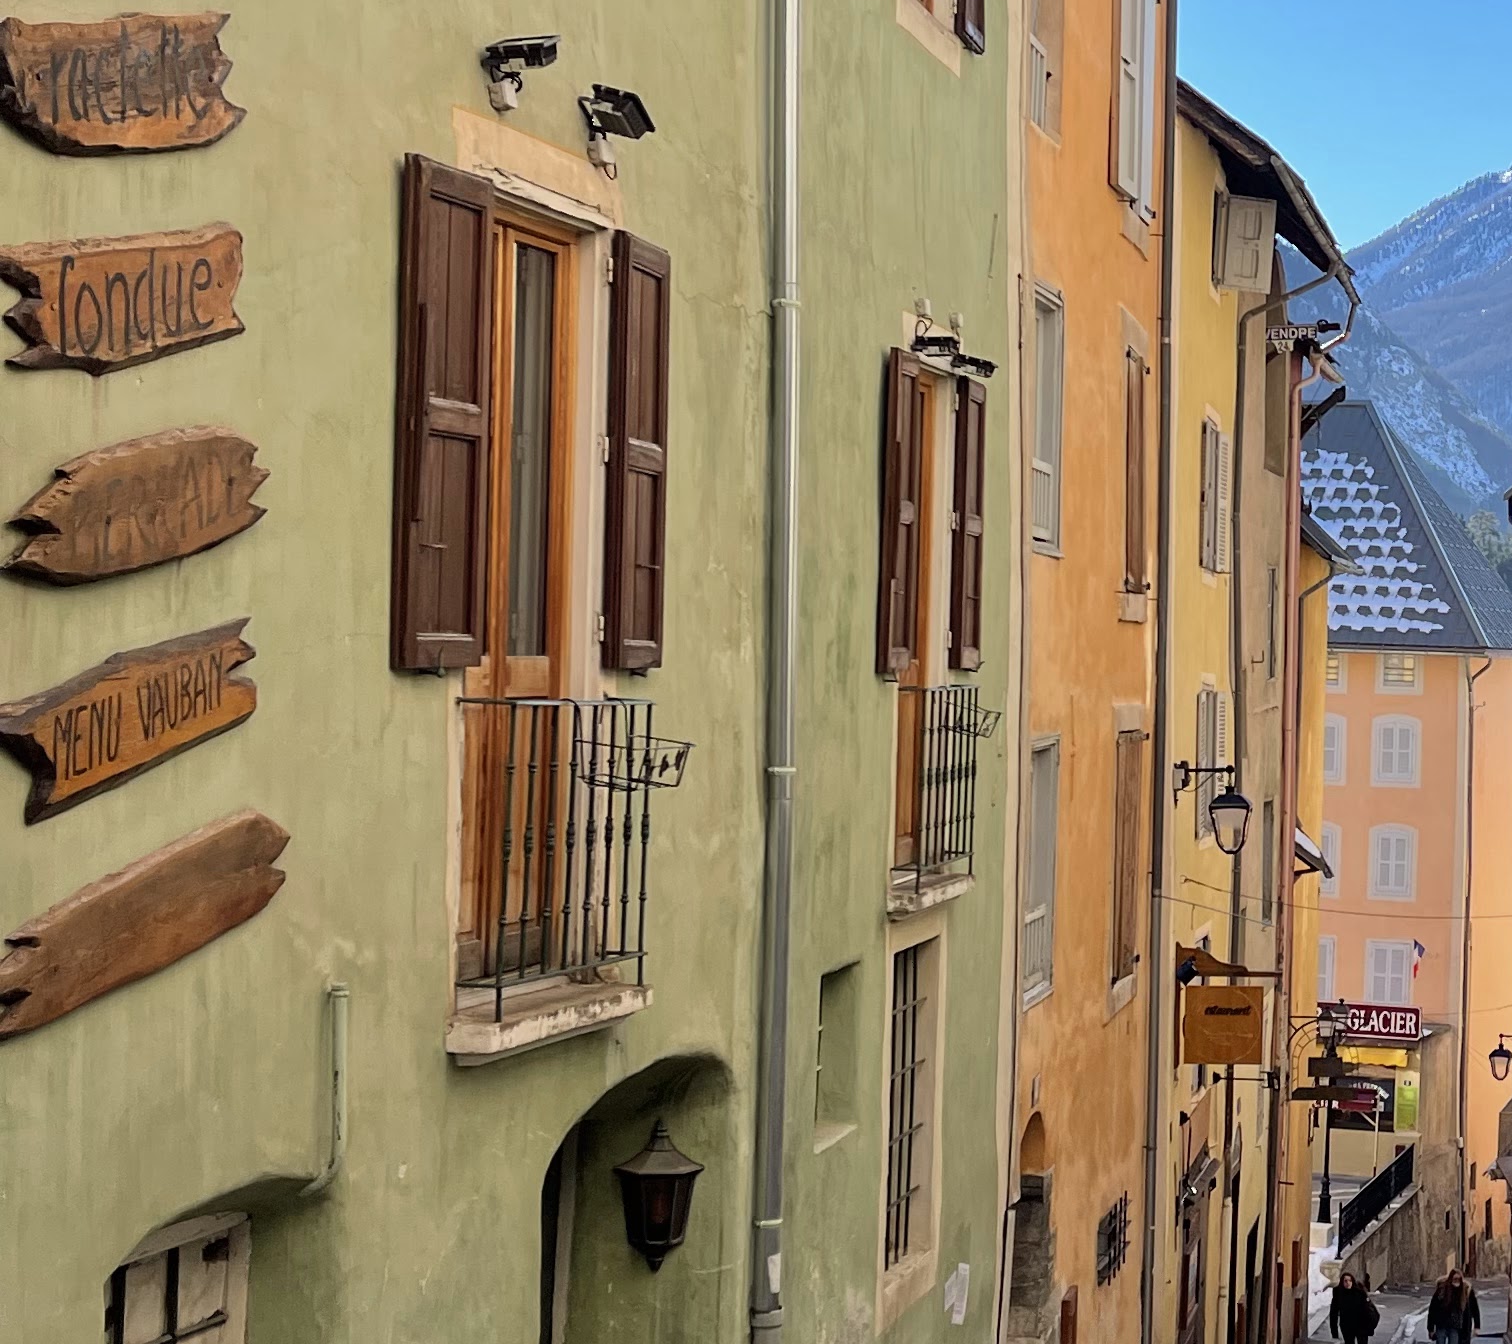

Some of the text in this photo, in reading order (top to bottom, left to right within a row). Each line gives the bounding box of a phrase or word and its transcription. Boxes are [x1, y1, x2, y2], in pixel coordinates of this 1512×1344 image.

[57, 248, 215, 355] fondue
[52, 649, 224, 780] MENU VAUBAN
[1347, 1008, 1417, 1035] GLACIER
